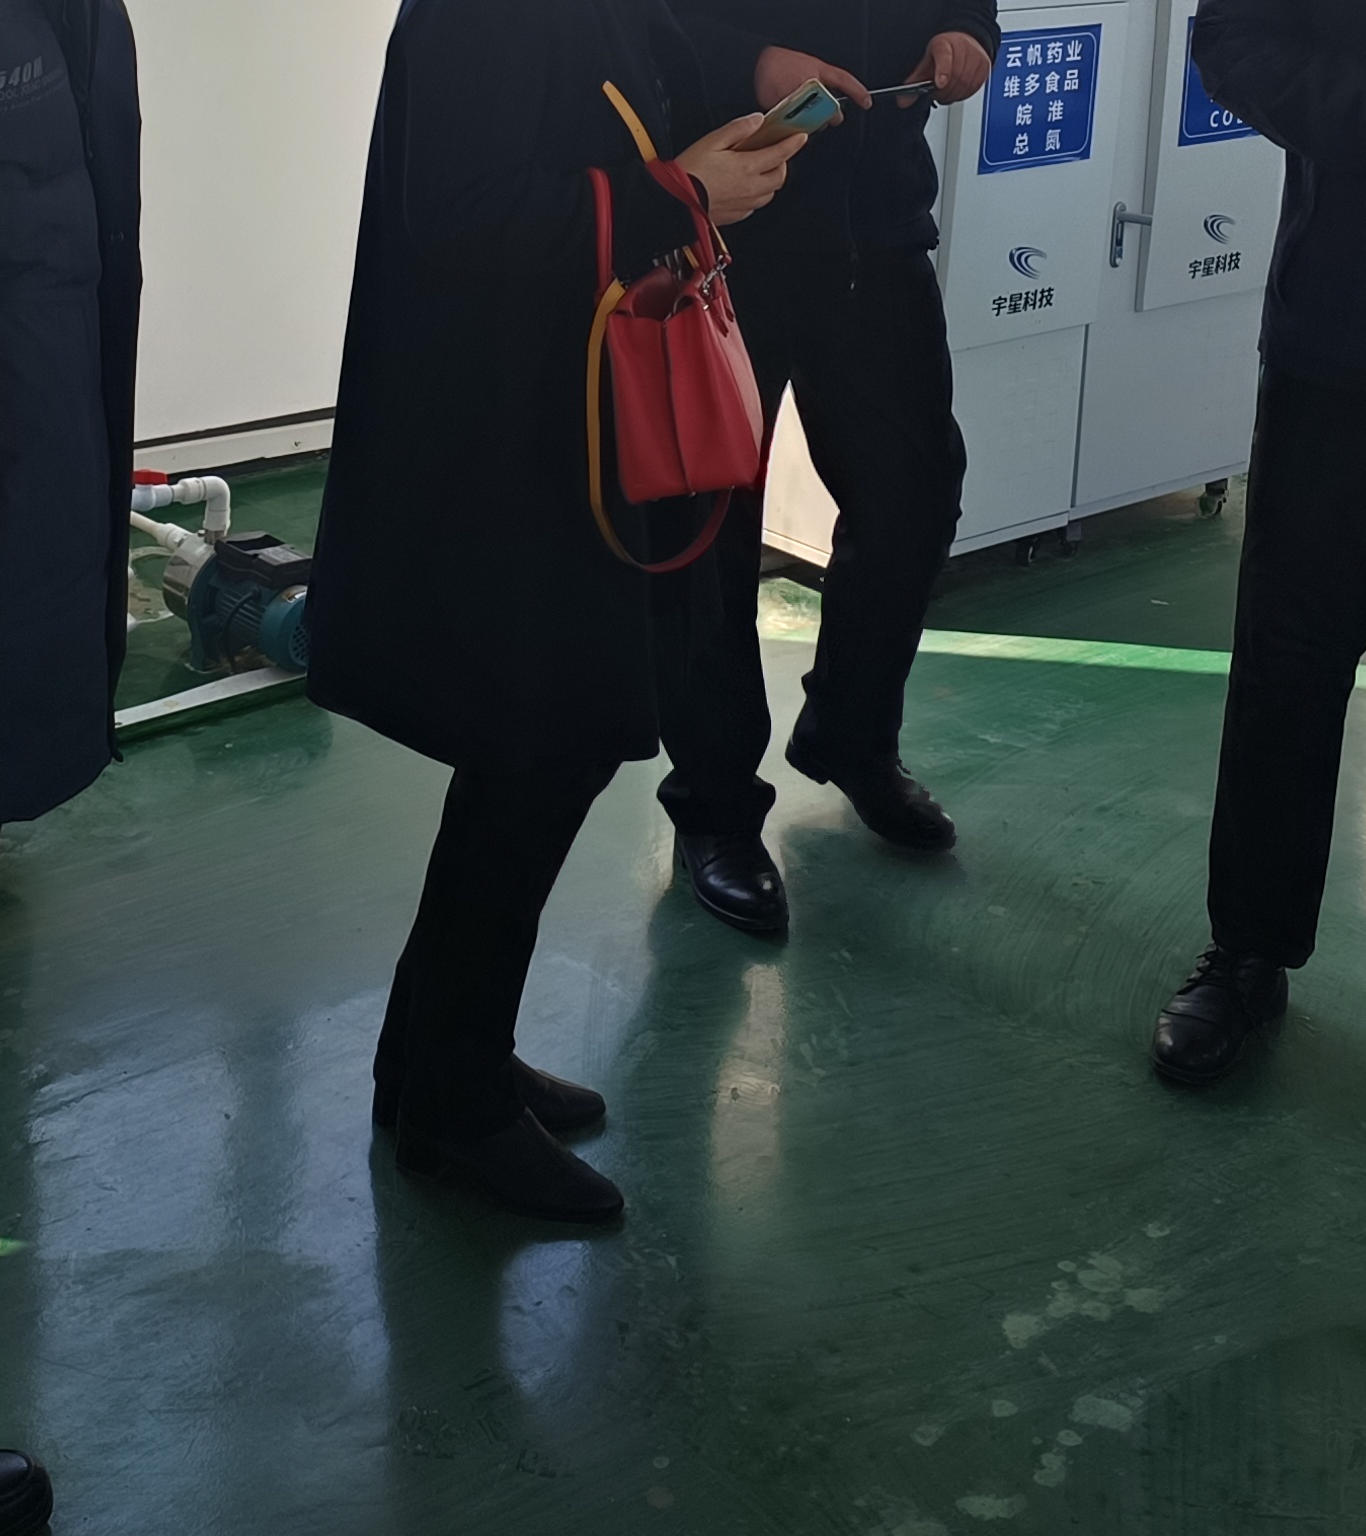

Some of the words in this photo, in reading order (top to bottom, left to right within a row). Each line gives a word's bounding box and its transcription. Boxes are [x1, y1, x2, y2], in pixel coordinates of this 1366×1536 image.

[1006, 40, 1083, 67] 云帆药业
[1003, 69, 1079, 98] 维多食品
[1210, 109, 1243, 128] CO
[1188, 252, 1241, 279] 宇星科技
[991, 287, 1054, 316] 宇星科技
